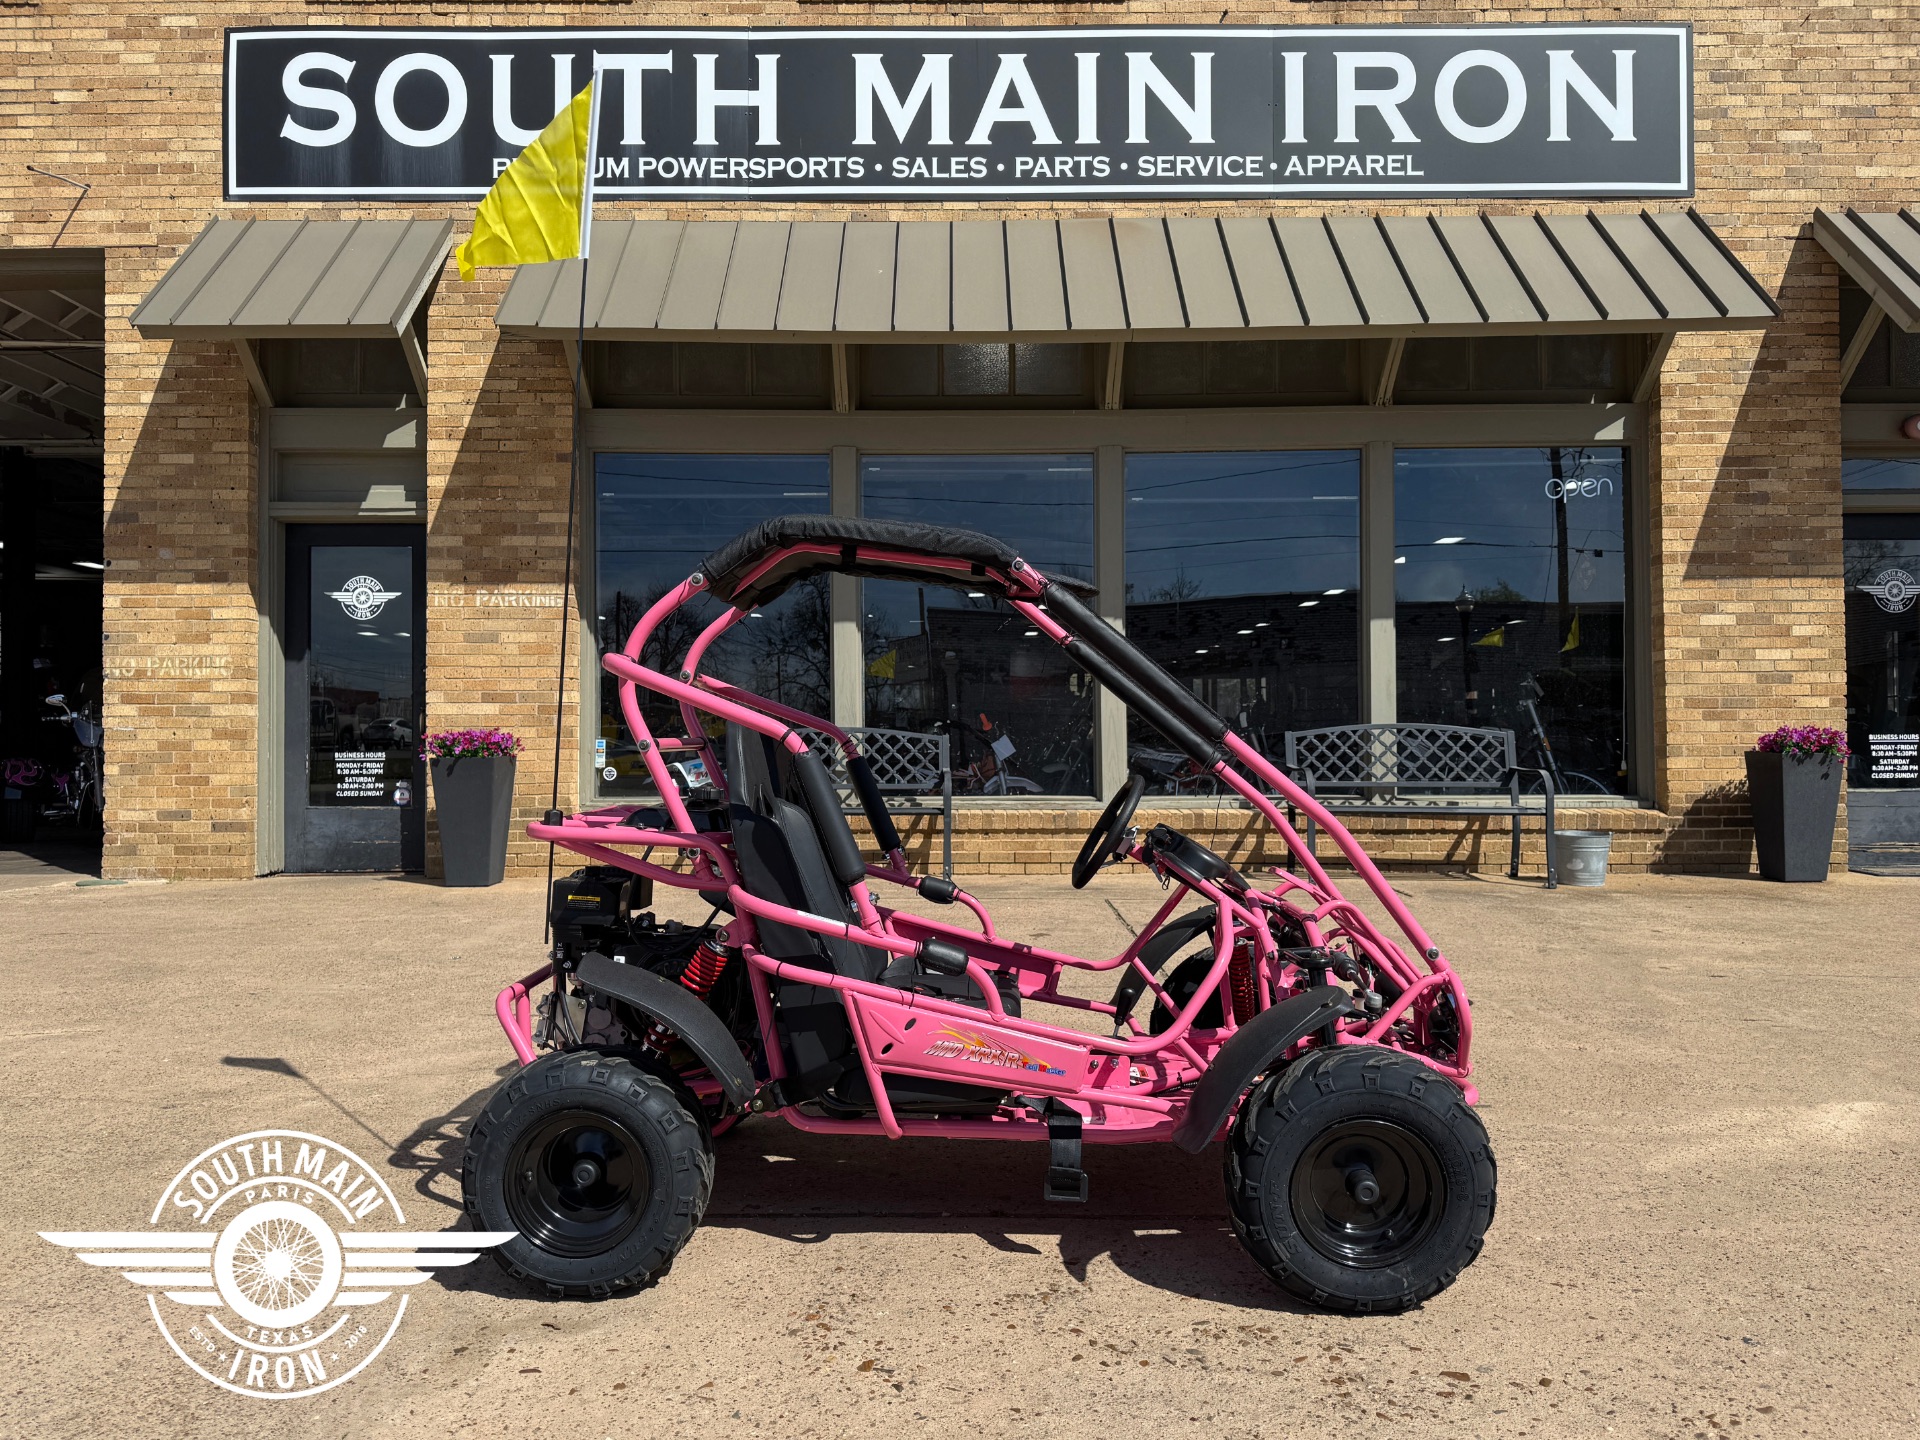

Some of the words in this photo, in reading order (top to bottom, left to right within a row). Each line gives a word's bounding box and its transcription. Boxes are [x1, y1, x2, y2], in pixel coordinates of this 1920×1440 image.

[280, 50, 780, 147] SOUTH
[852, 52, 1215, 145] MAIN
[1281, 50, 1637, 143] IRON
[639, 156, 865, 179] POWERSPORTS
[892, 156, 988, 179] SALES
[1015, 155, 1111, 178] PARTS
[1138, 155, 1264, 178] SERVICE
[1284, 154, 1425, 177] APPAREL
[1545, 478, 1613, 503] open
[345, 577, 364, 591] SOUTH
[365, 578, 381, 591] MAIN
[1878, 570, 1896, 584] SOUTH
[1897, 571, 1913, 584] MAIN
[433, 588, 465, 607] NO
[476, 588, 564, 607] PARKING
[104, 656, 137, 677] NO
[146, 655, 234, 677] PARKING
[922, 1040, 965, 1059] MID
